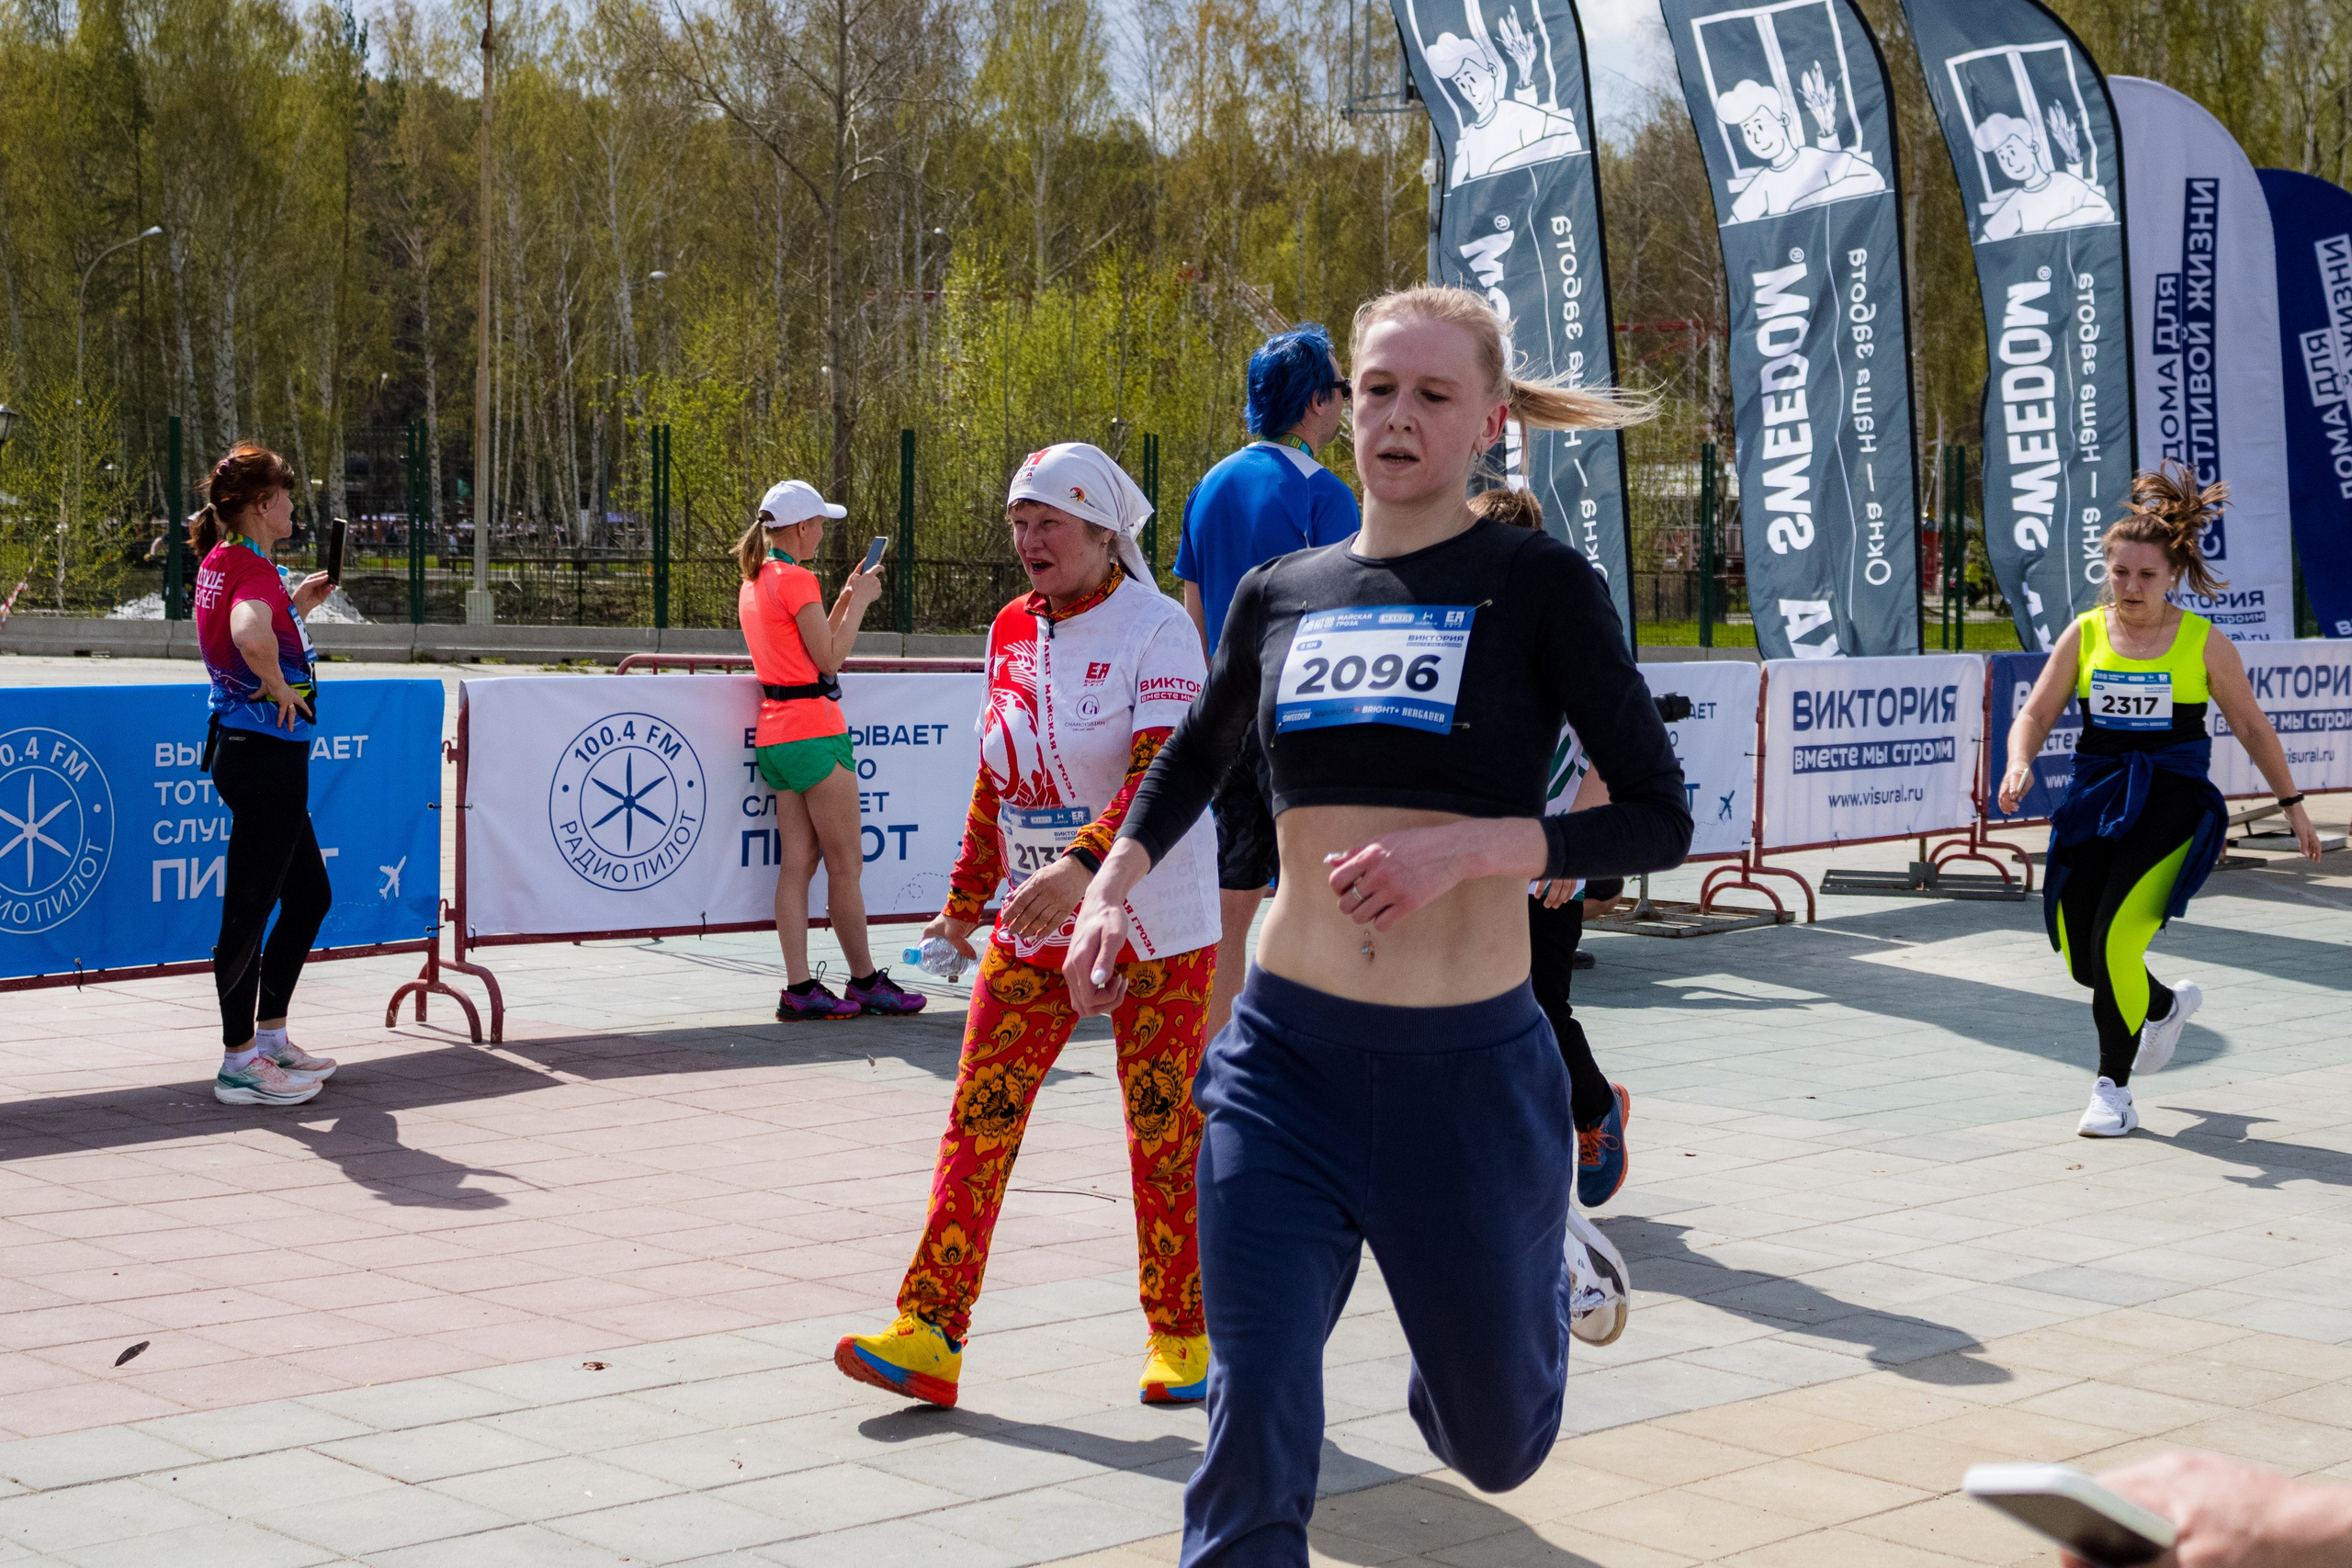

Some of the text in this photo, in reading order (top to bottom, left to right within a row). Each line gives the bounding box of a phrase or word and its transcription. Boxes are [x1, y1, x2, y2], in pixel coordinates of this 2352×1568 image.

[2156, 276, 2180, 350] ДЛЯ
[2182, 181, 2222, 558] ССТЛИВОЙ ЖИЗНИ
[2306, 333, 2343, 397] ДЛЯ
[1408, 634, 1464, 642] ВИКТОРИЯ
[1140, 677, 1202, 694] ВИКТОР
[1295, 654, 1442, 695] 2096
[1141, 692, 1179, 704] вместе
[1793, 685, 1959, 732] ВИКТОРИЯ
[2102, 695, 2159, 715] 2317
[1283, 712, 1312, 723] SWEEDOM
[1402, 706, 1445, 724] BERGAUER
[2280, 714, 2305, 730] мы
[2308, 711, 2352, 733] строи
[574, 720, 683, 763] 100.4 FM
[1045, 683, 1057, 750] МАЙСКАЯ
[1054, 753, 1076, 800] ГРОЗА
[1794, 739, 1953, 771] вместе мы строим
[0, 737, 90, 783] 0.4 FM
[1828, 784, 1924, 808] www.visural.ru
[1014, 842, 1064, 871] 213
[1131, 916, 1156, 956] ГРОЗА
